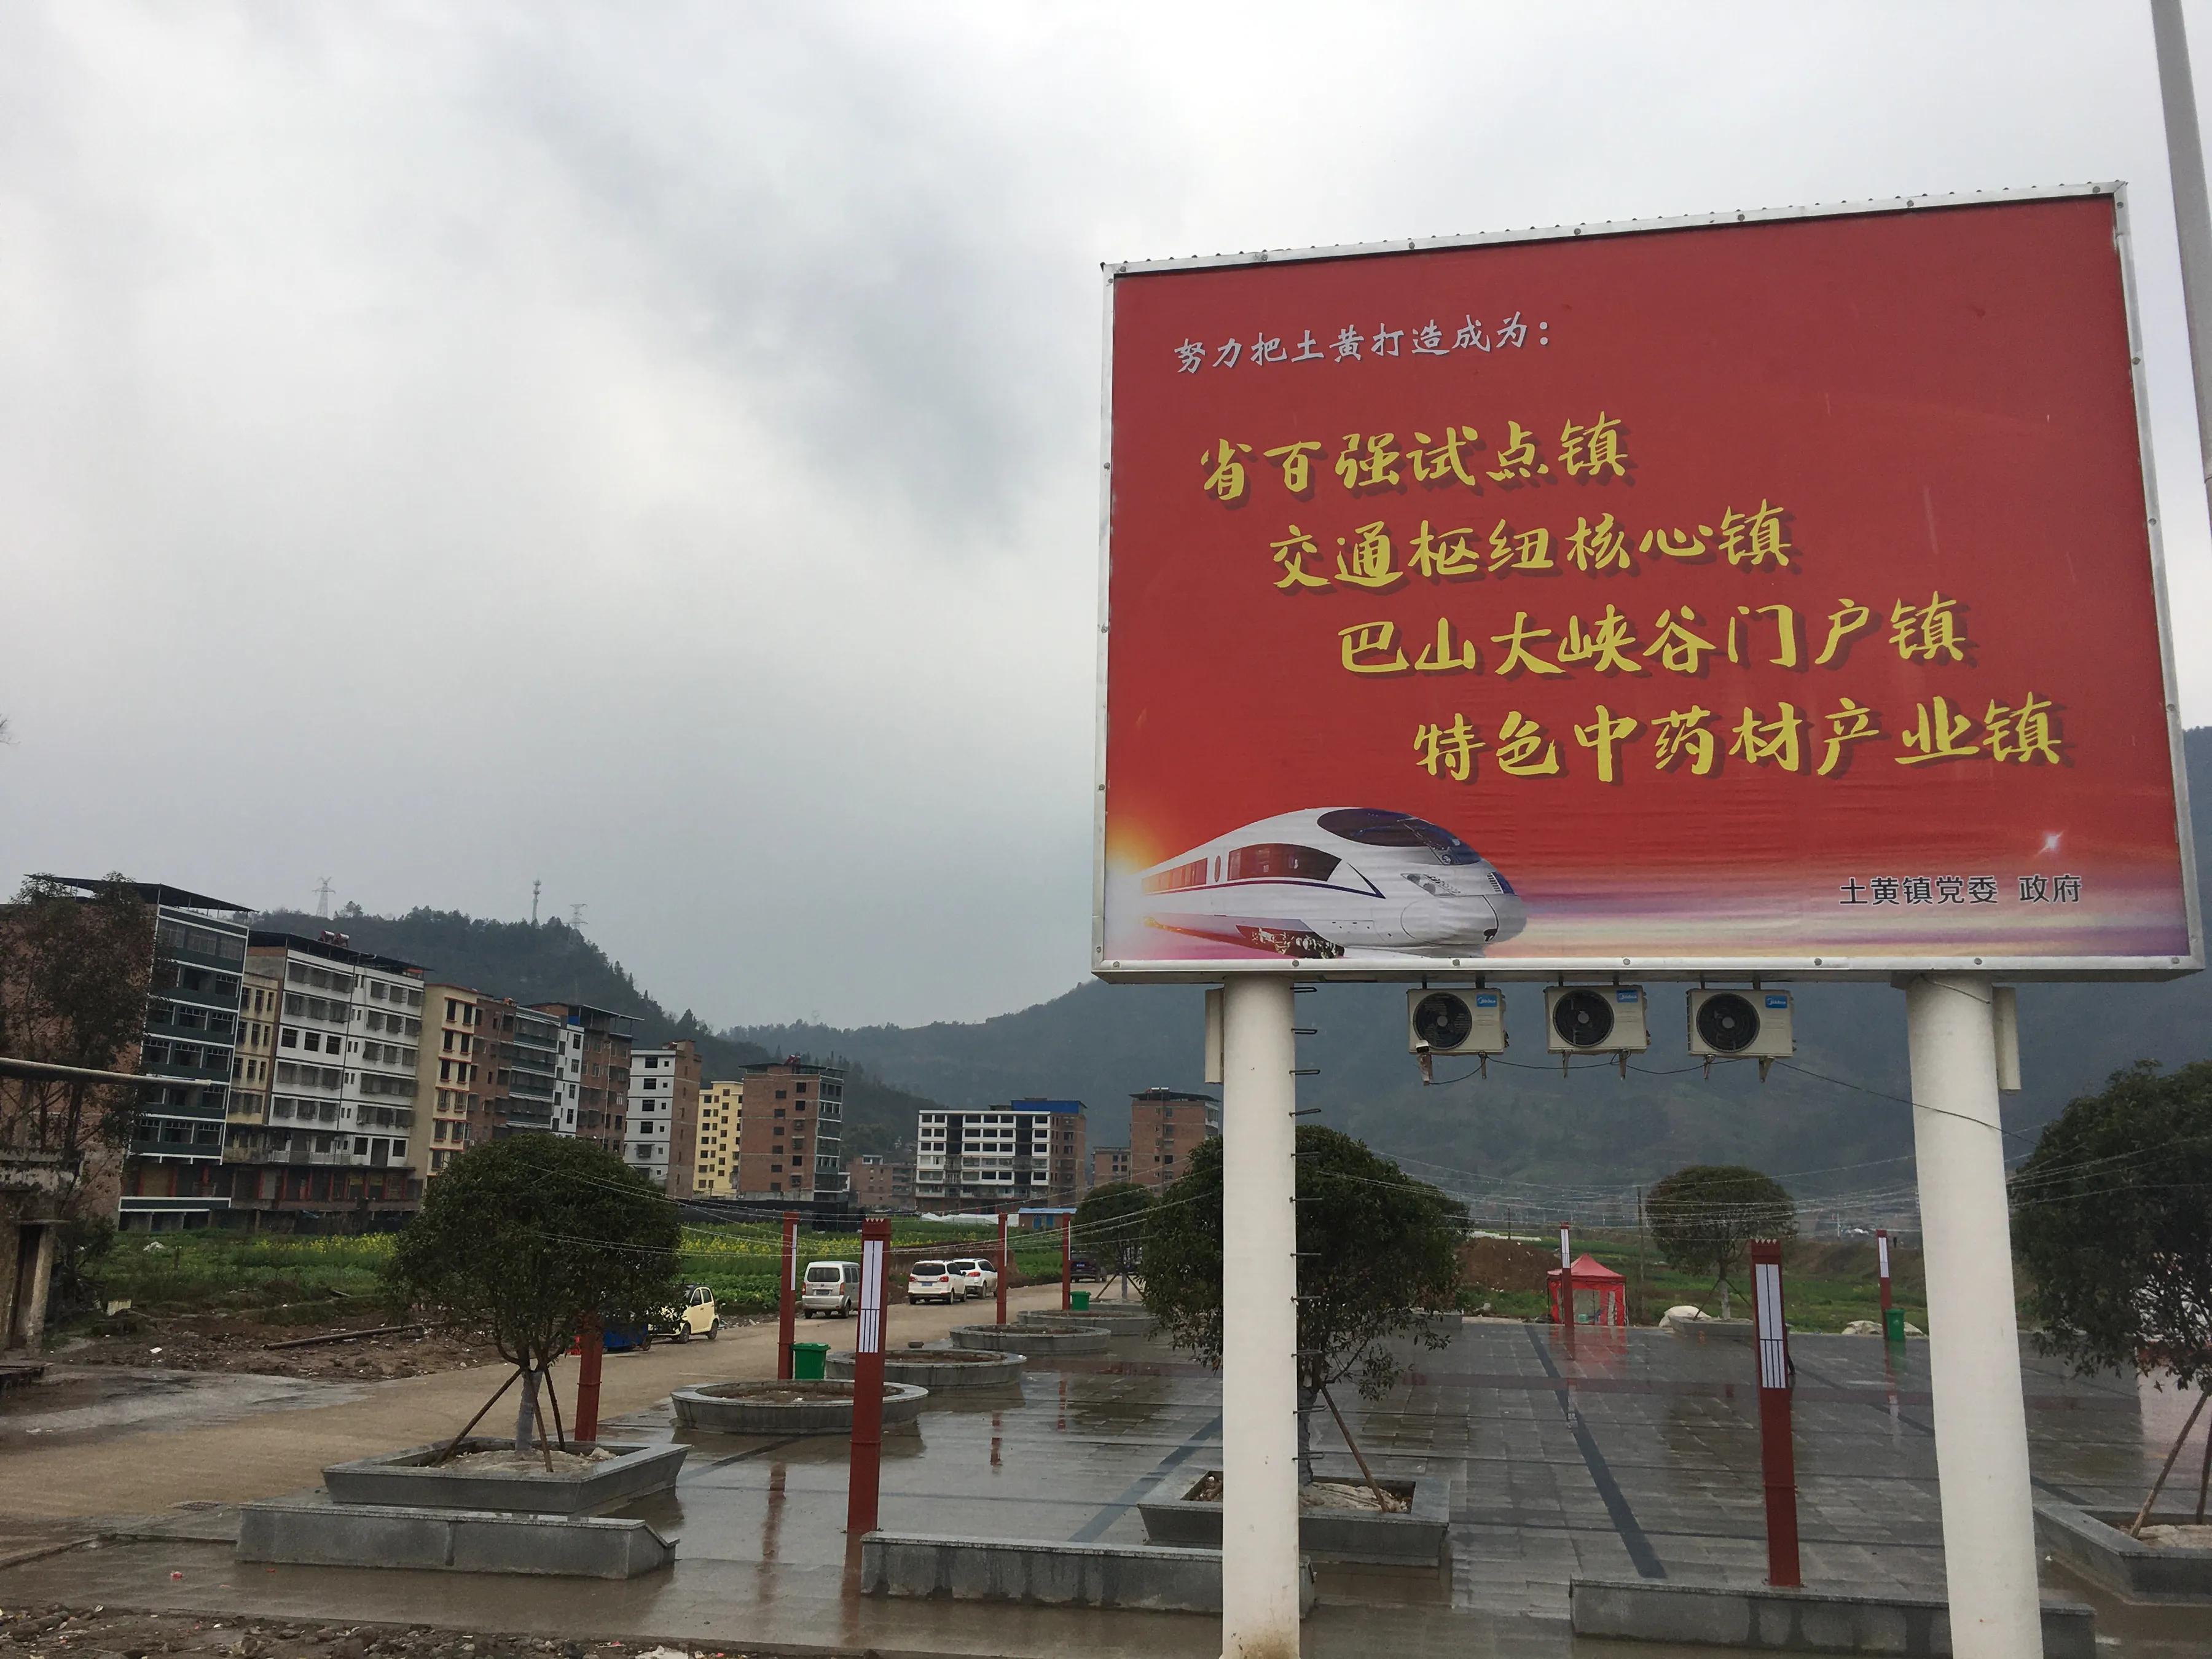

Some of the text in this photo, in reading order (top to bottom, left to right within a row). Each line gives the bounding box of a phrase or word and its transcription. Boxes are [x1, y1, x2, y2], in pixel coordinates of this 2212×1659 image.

[1201, 412, 1627, 501] 省百强试点镇
[1269, 498, 1790, 588] 交通枢纽核心镇
[1338, 591, 1966, 675] 巴山大峡谷门户镇
[1413, 692, 2061, 783] 特色中药材产业镇
[1839, 874, 2082, 906] 土黄镇党委 政府
